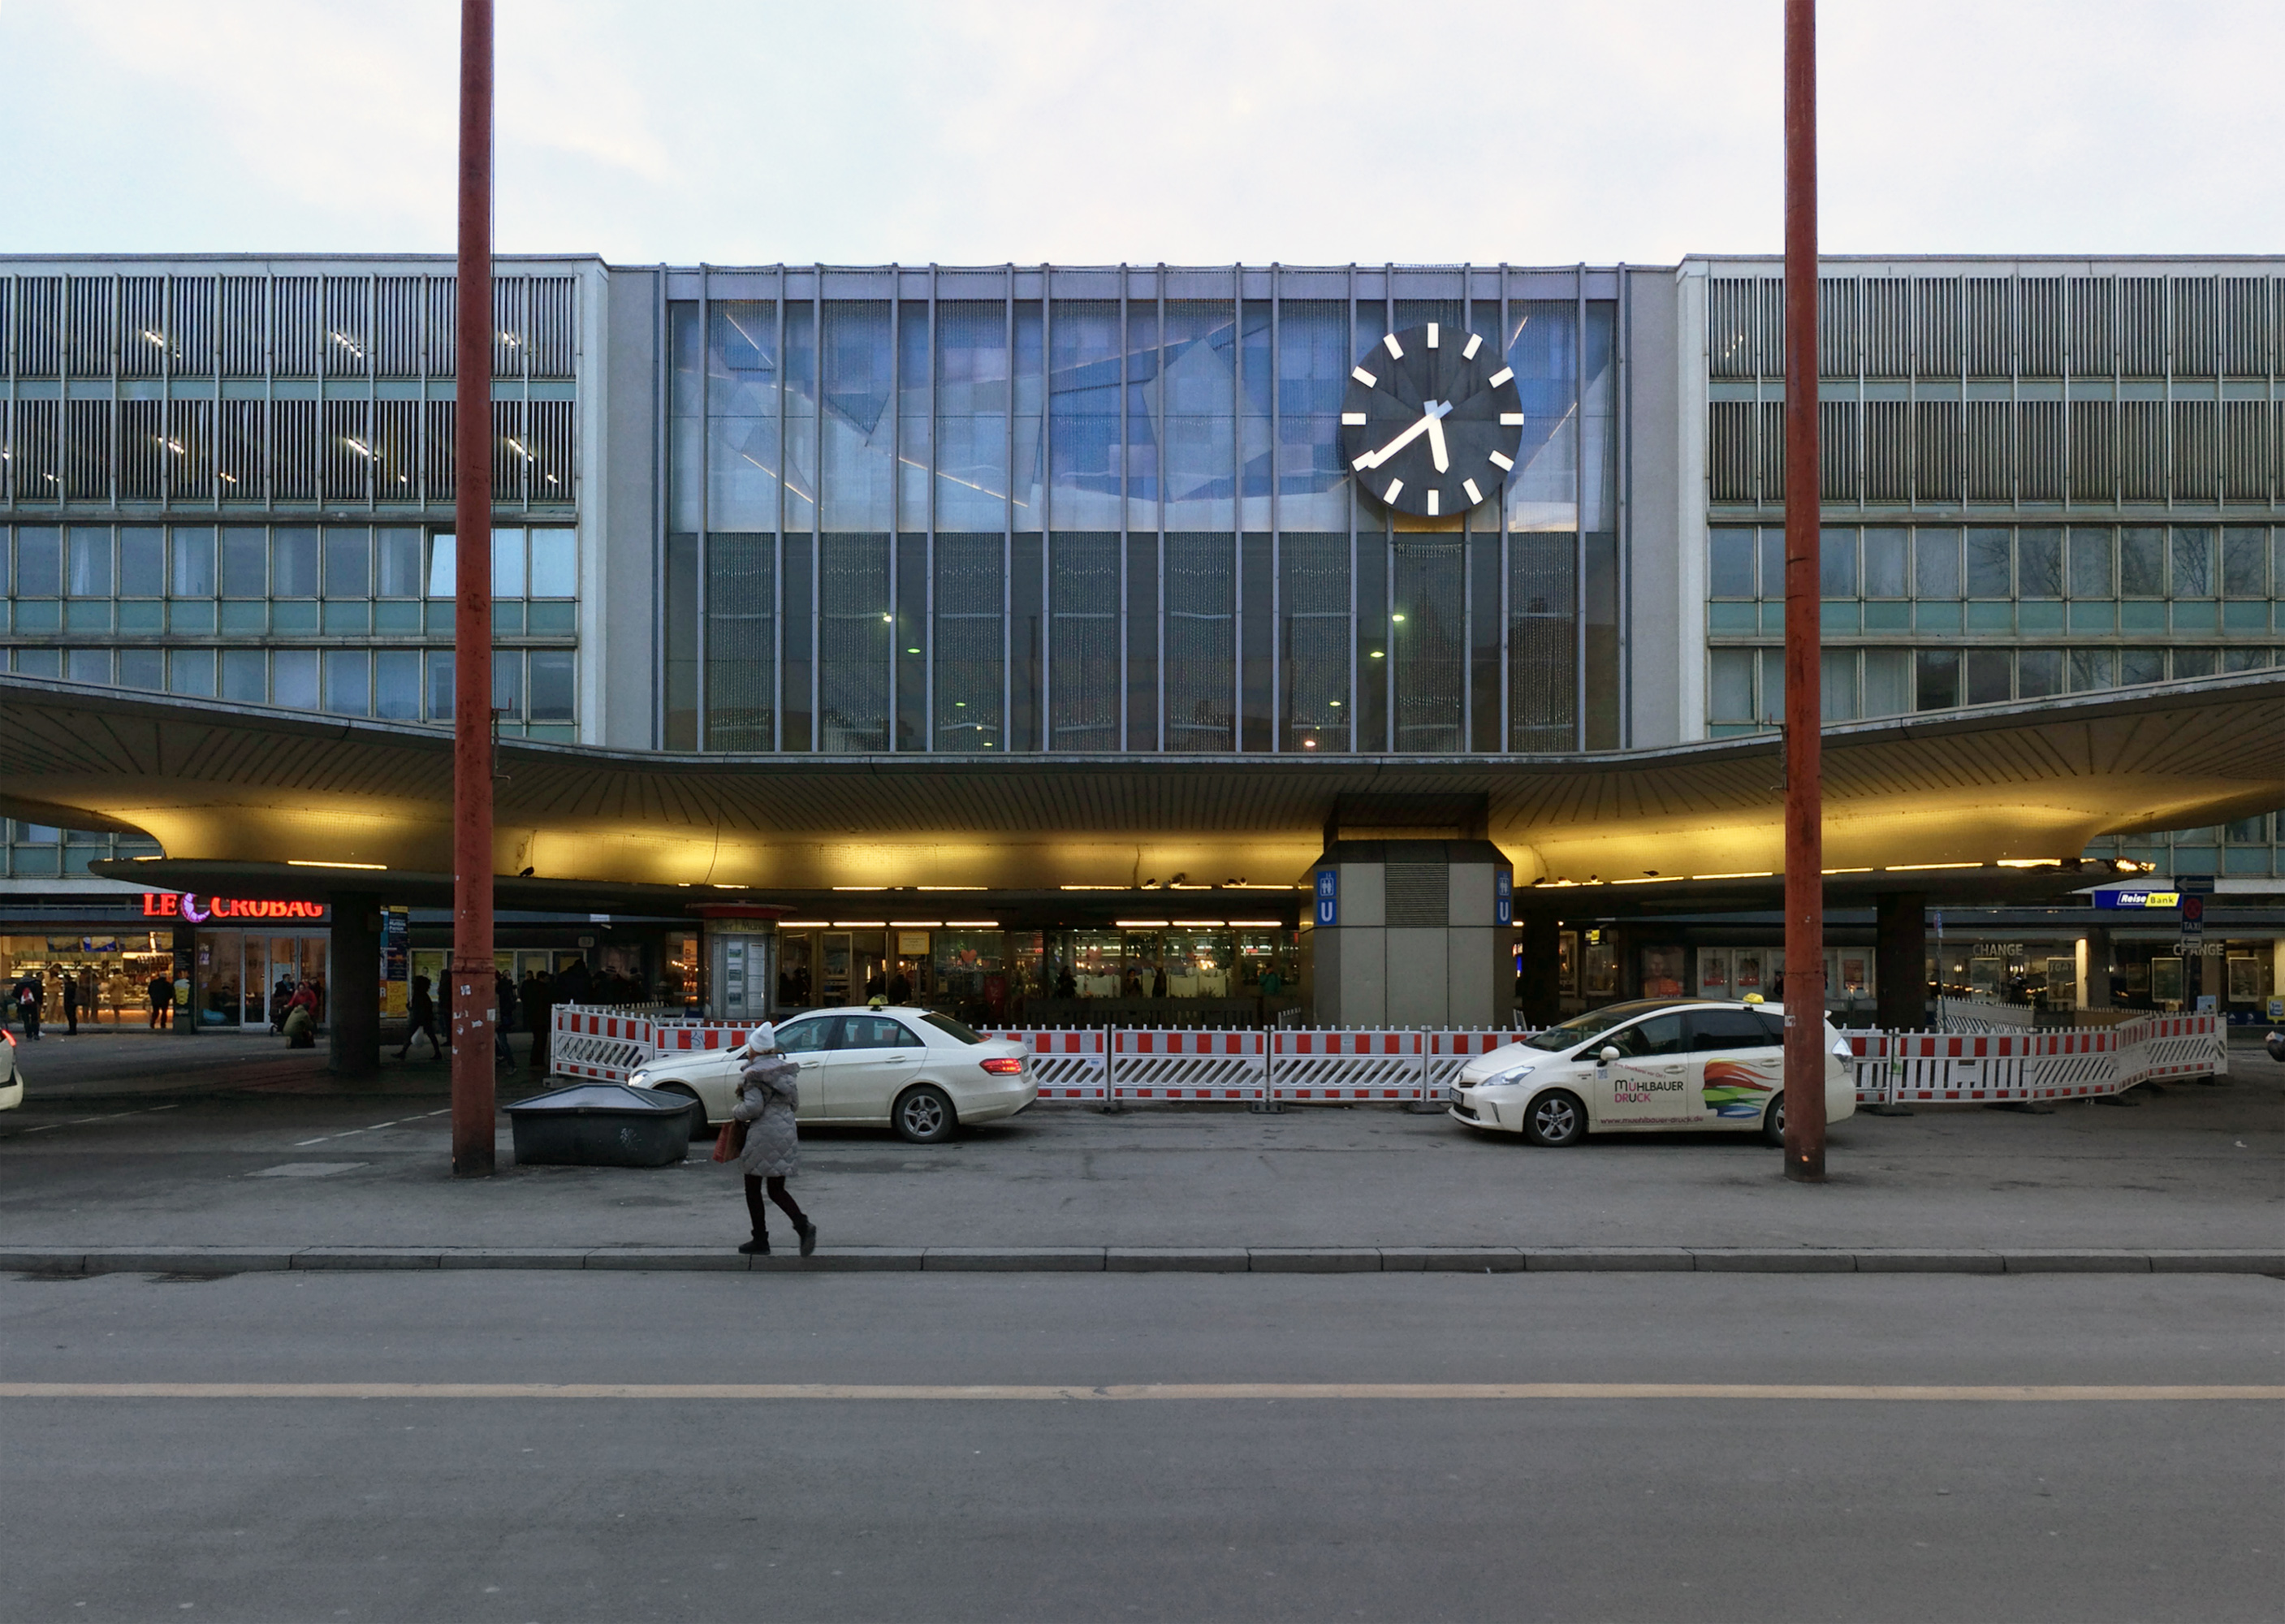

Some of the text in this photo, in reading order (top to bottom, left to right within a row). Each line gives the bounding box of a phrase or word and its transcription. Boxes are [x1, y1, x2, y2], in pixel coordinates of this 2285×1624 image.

[2121, 894, 2147, 903] Reise
[144, 894, 323, 917] LE CROBAG
[1321, 901, 1333, 922] U
[1500, 901, 1510, 922] U
[2183, 922, 2201, 931] TAXI
[1972, 944, 2023, 956] CHANGE
[1614, 1093, 1652, 1103] DRUCK
[1600, 1116, 1704, 1124] www.muehlbauer-druck.de
